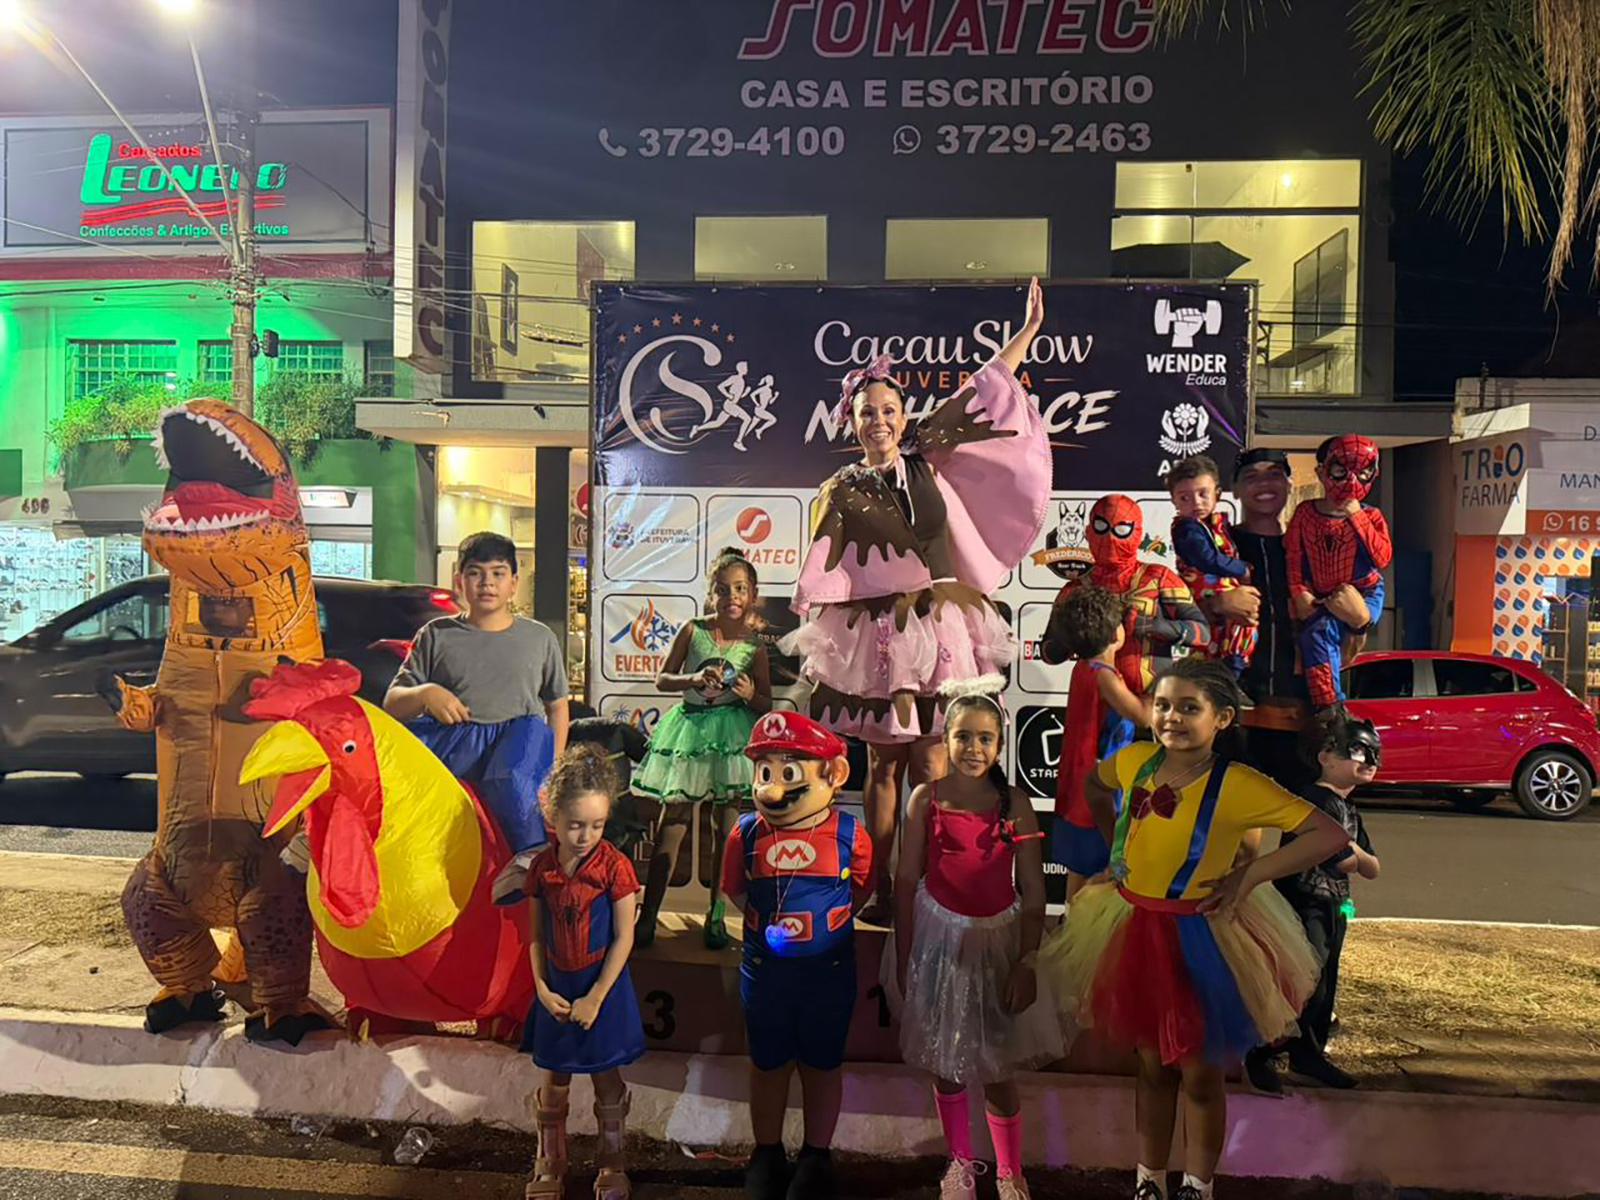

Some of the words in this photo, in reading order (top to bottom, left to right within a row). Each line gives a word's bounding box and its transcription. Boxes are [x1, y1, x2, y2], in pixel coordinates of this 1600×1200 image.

[740, 79, 850, 109] CASA
[863, 79, 887, 108] E
[901, 70, 1153, 109] ESCRITÓRIO
[639, 125, 846, 157] 3729-4100
[937, 122, 1152, 154] 3729-2463
[157, 225, 167, 237] &
[1146, 353, 1227, 373] WENDER
[1185, 373, 1227, 386] Educa
[1461, 482, 1521, 508] FARMA
[1567, 515, 1590, 532] 16
[642, 989, 676, 1040] 3
[867, 984, 891, 1028] 1
